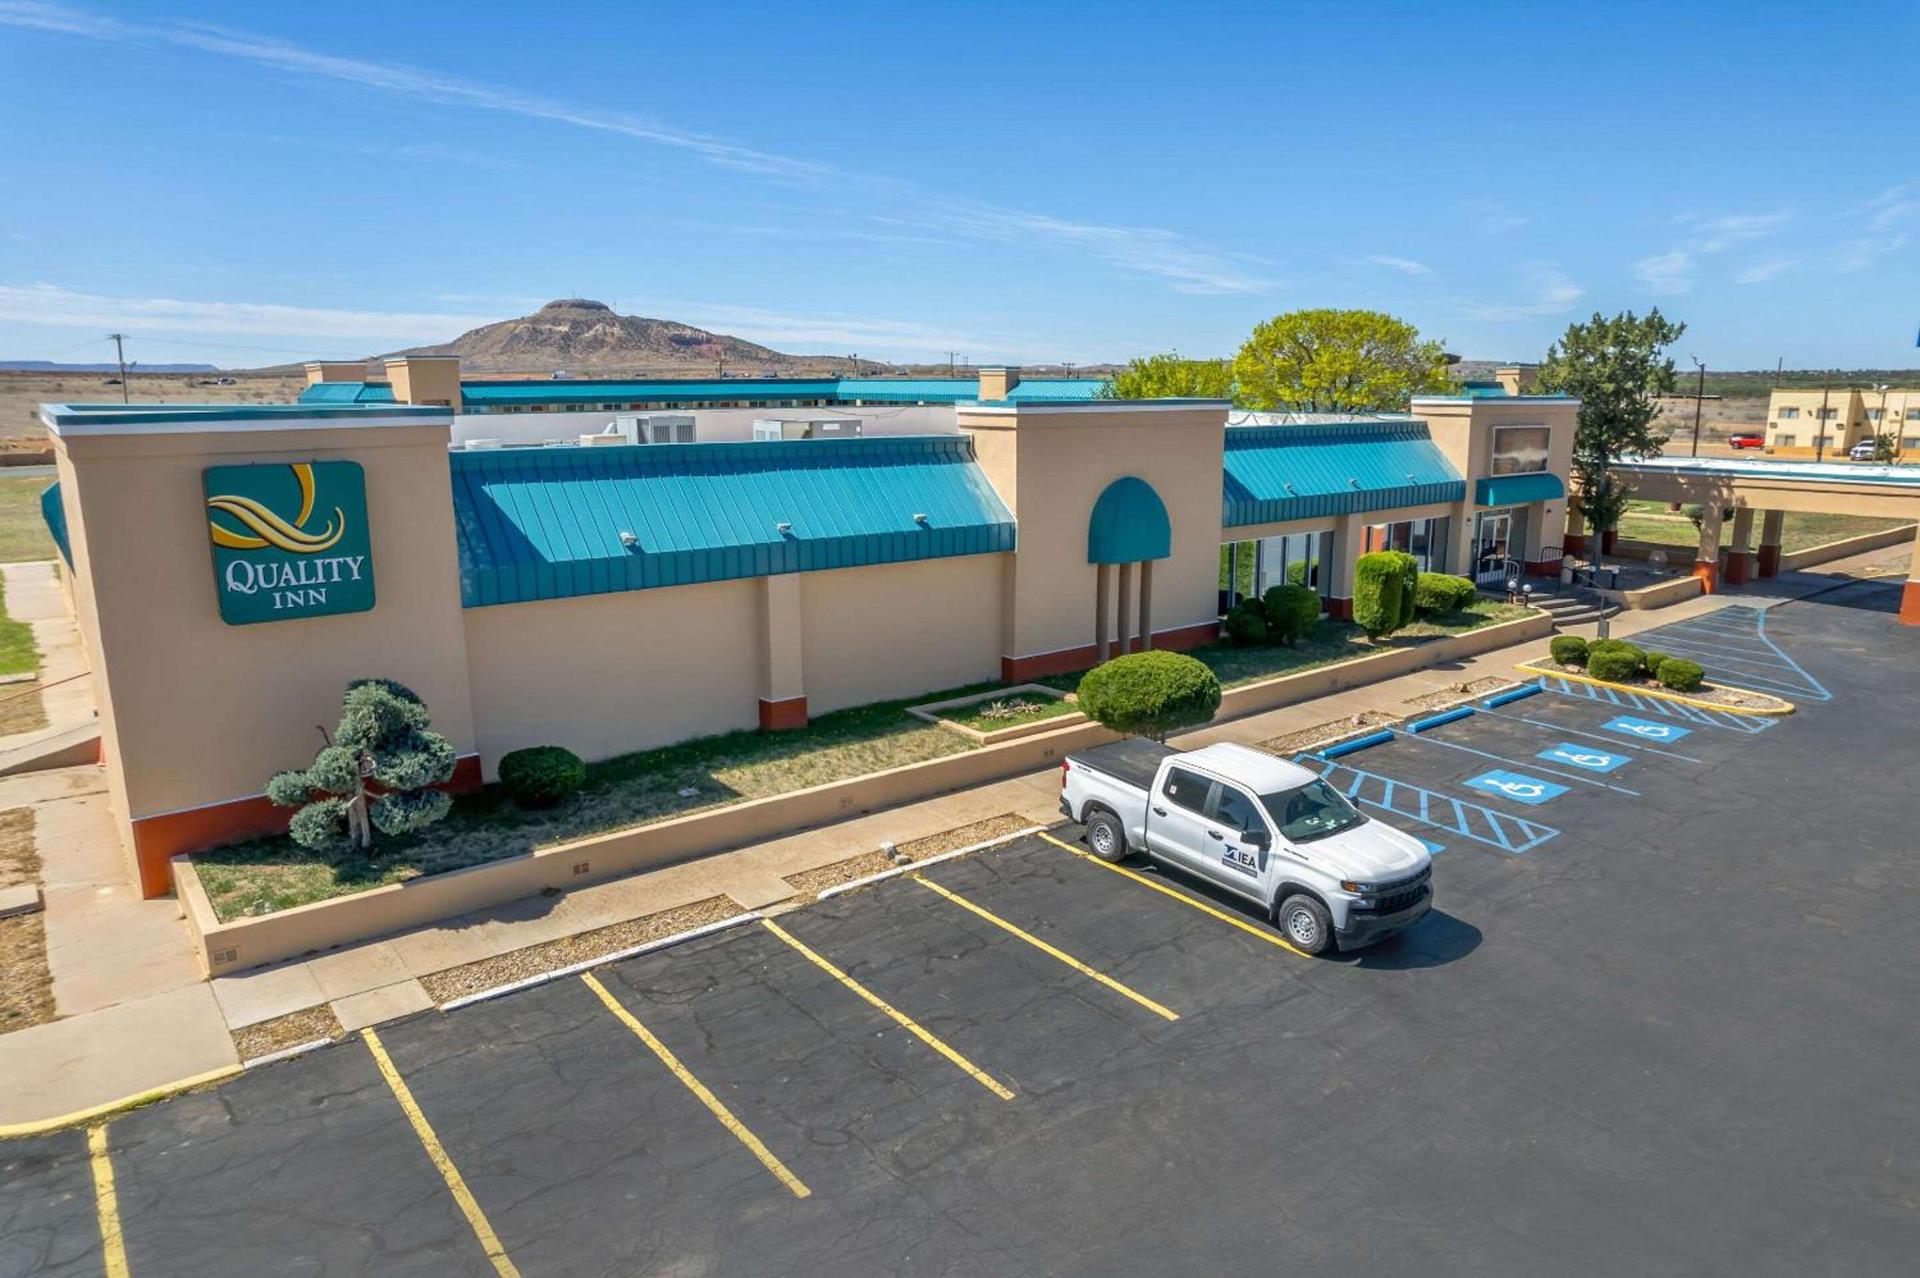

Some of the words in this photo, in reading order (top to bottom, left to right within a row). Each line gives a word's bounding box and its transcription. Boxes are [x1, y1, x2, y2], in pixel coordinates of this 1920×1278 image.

[226, 556, 364, 594] QUALITY
[273, 588, 327, 609] INN
[1238, 851, 1256, 869] IEA
